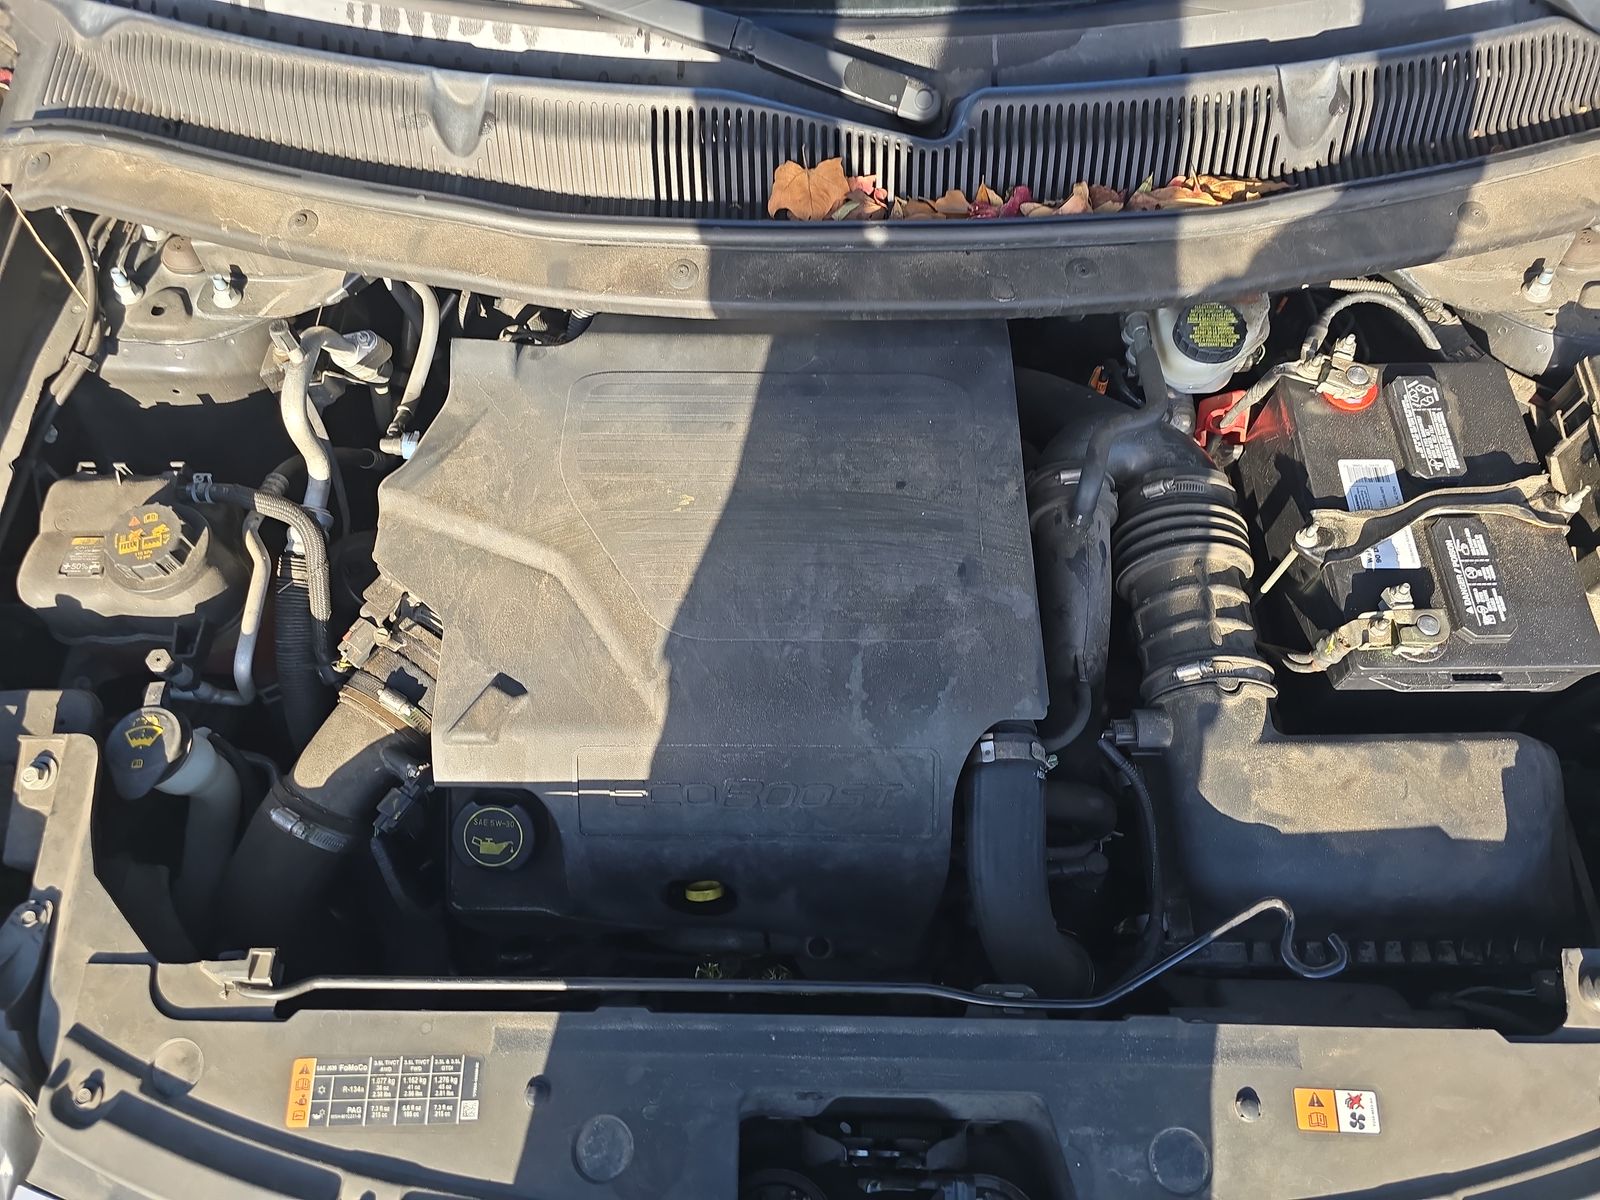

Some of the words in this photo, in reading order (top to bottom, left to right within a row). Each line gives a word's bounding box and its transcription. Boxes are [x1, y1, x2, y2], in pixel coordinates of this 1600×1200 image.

[1445, 539, 1460, 568] POISON
[1456, 573, 1473, 606] DANGER
[473, 818, 488, 827] SAE
[490, 819, 515, 829] 5W-30
[339, 1063, 368, 1072] FoMoCo
[387, 1077, 396, 1086] kg
[418, 1076, 427, 1085] kg
[450, 1076, 458, 1085] kg
[342, 1085, 365, 1093] R-134a
[346, 1106, 362, 1114] PAG
